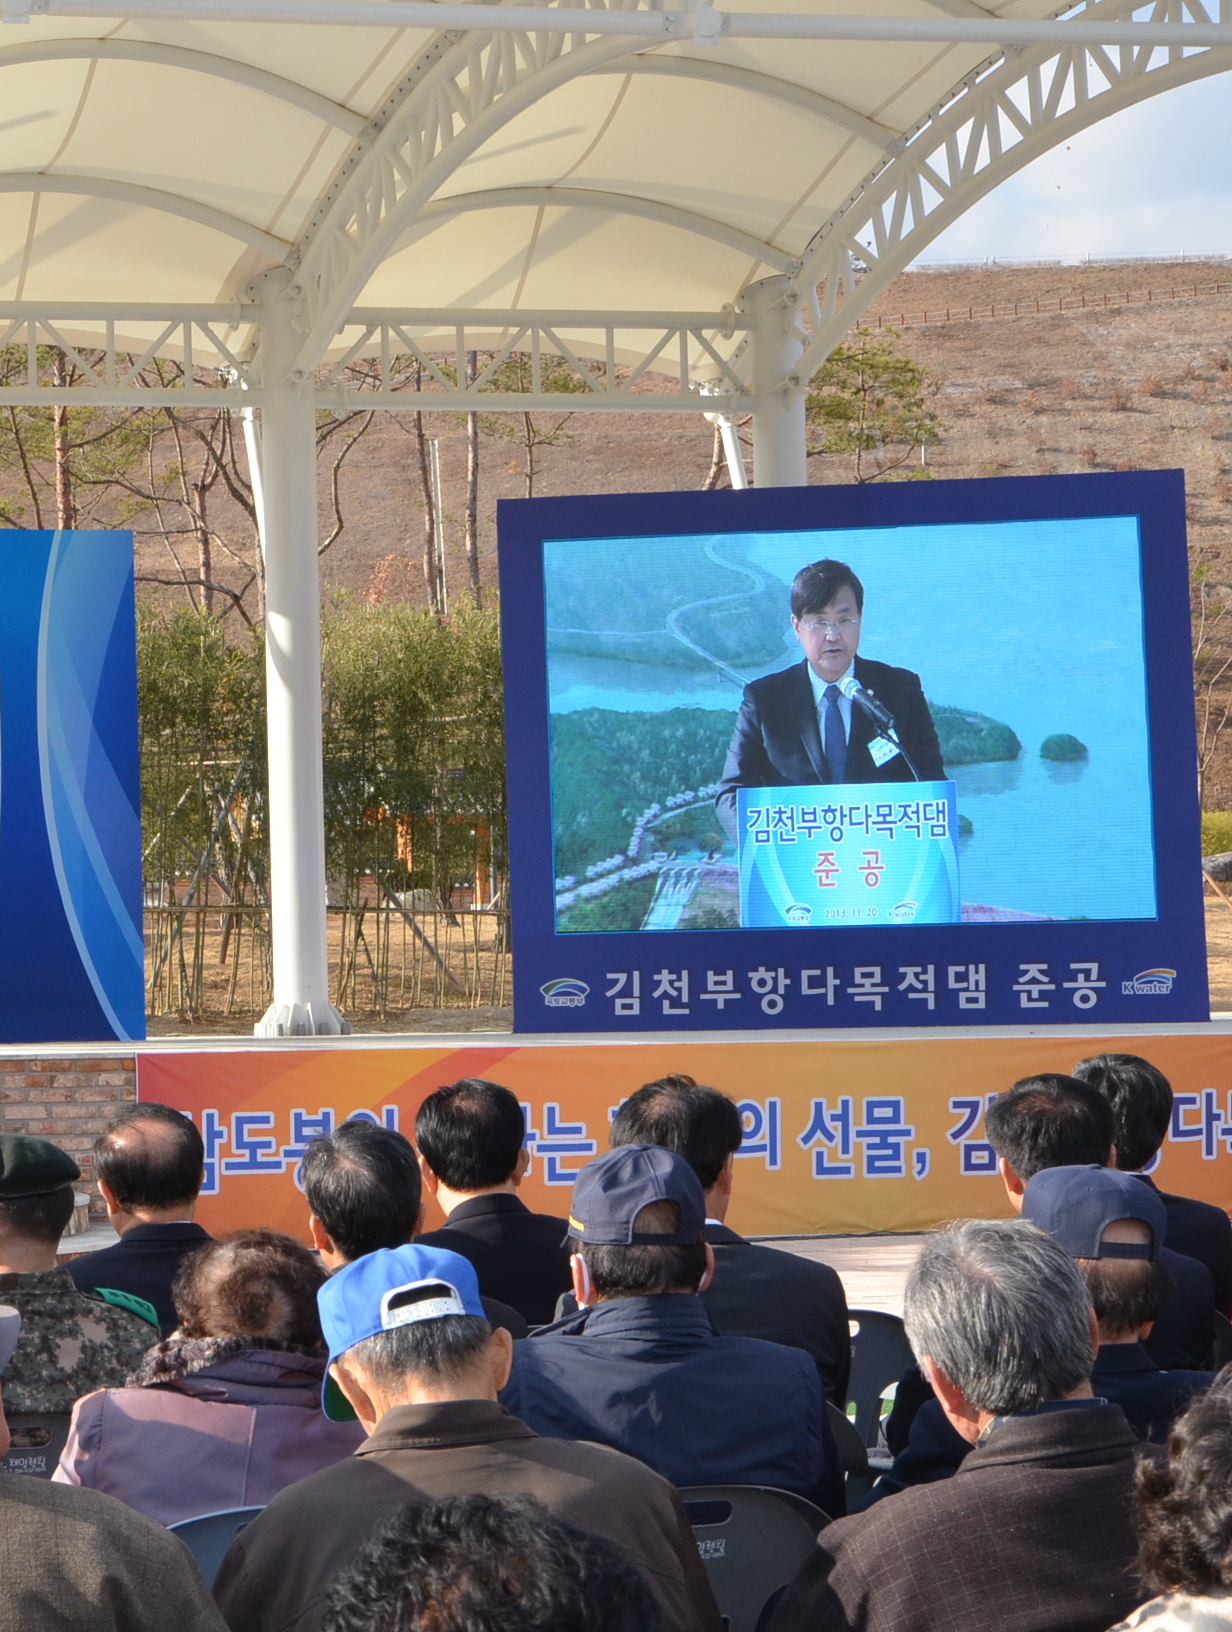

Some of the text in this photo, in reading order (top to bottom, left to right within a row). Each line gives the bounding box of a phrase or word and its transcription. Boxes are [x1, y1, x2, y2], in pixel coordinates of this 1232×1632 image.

[747, 800, 950, 845] 김천부항다목적댐
[604, 962, 1106, 1015] 김천부항다목적댐 준공
[798, 1095, 931, 1181] 선물,
